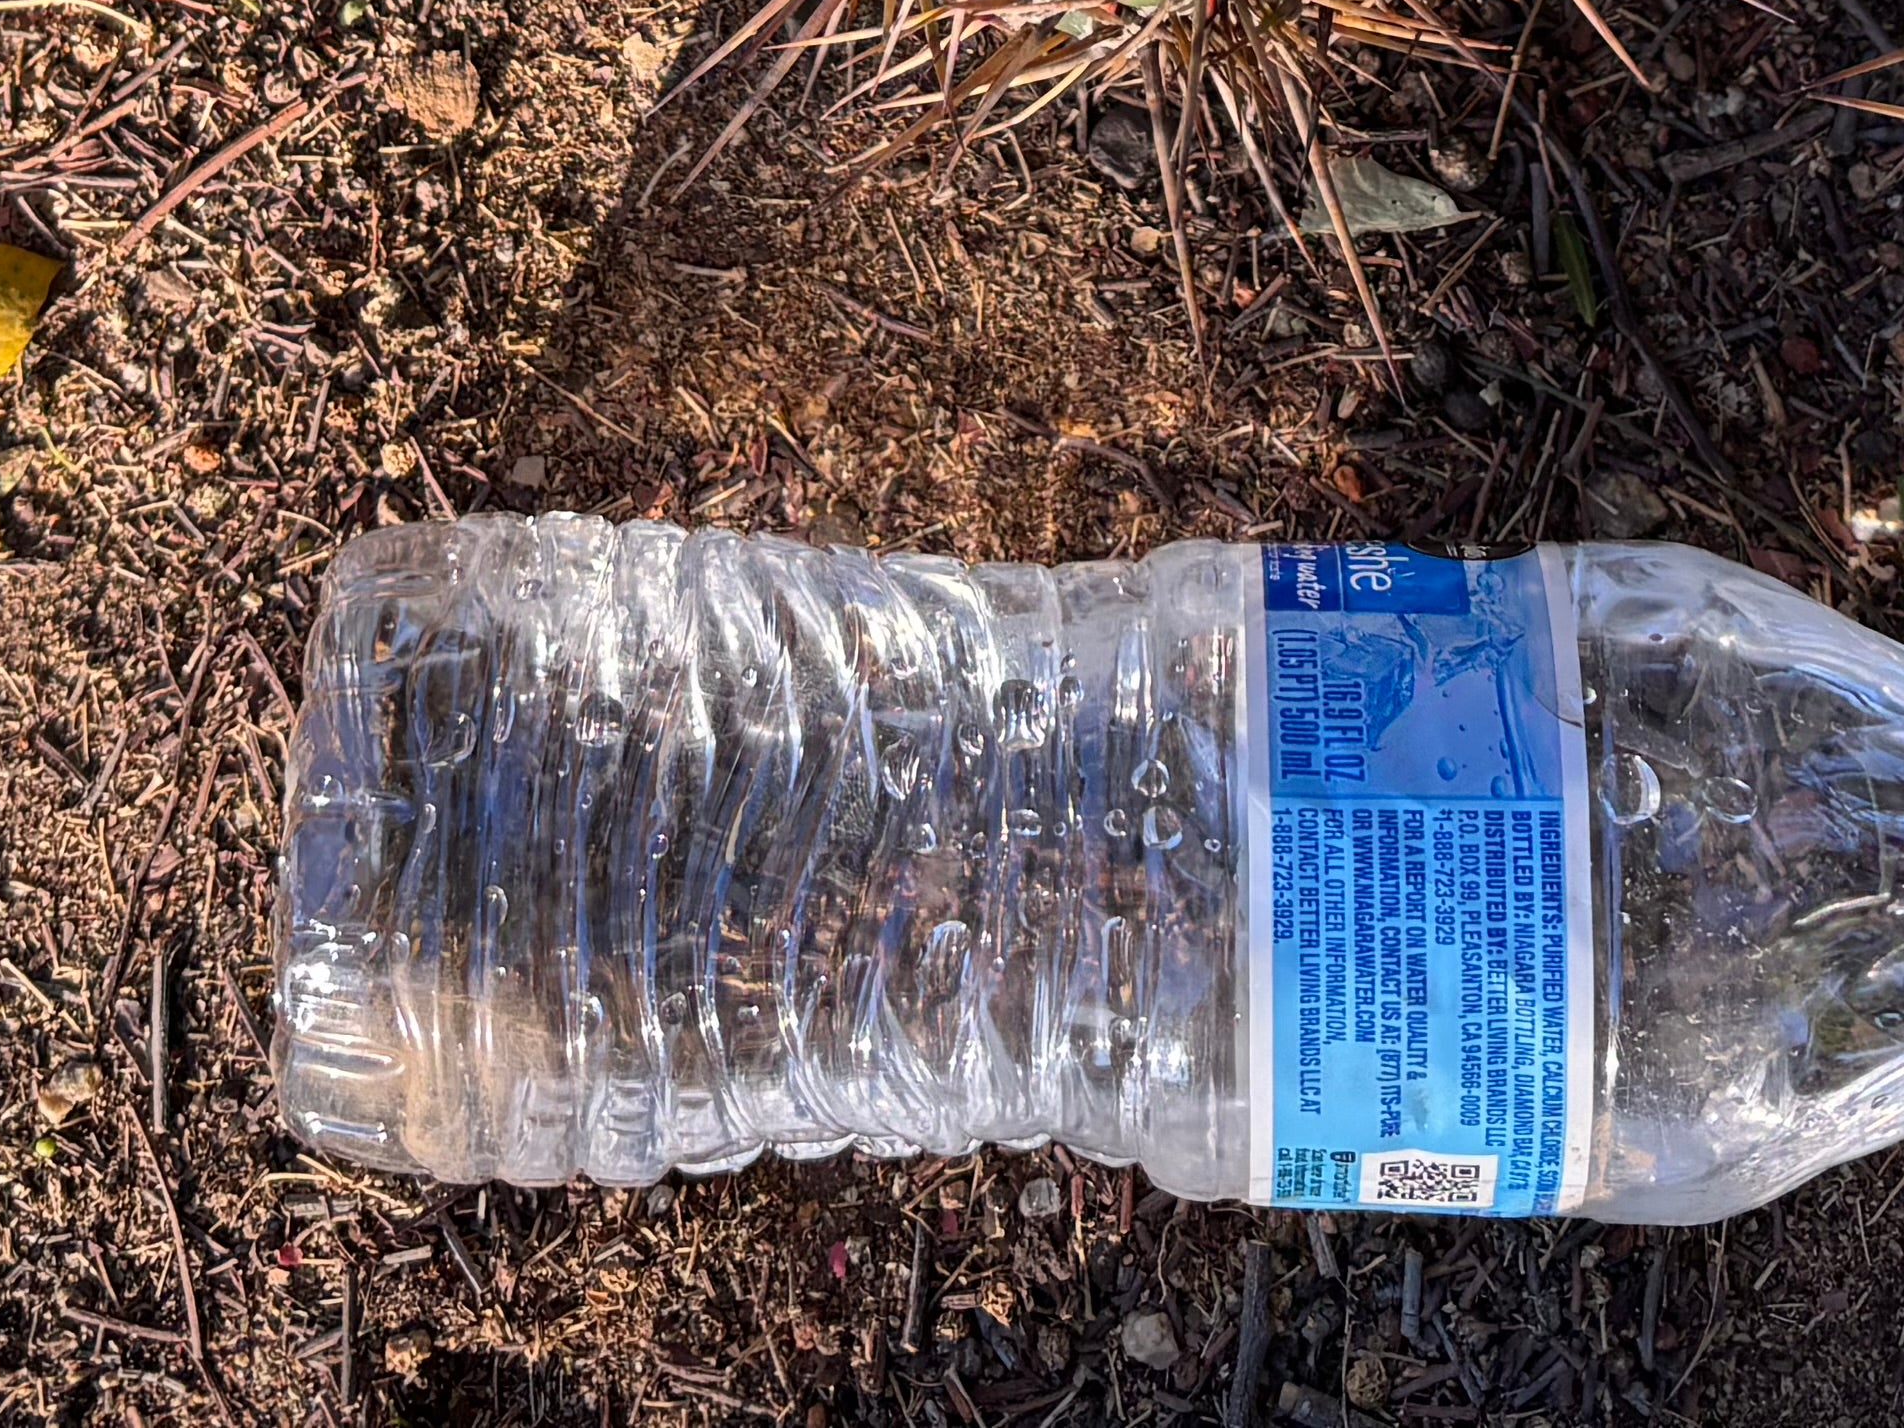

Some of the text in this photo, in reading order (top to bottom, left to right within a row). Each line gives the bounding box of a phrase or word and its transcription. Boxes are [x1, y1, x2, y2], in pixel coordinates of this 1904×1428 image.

[1296, 562, 1326, 609] water
[1273, 629, 1320, 779] (1.05 PT) 500 mL
[1323, 680, 1365, 783] 16.9 FL OZ
[1272, 808, 1294, 944] 1-888-723-3929.
[1512, 811, 1534, 885] BOTTLED
[1540, 811, 1562, 930] INGREDIENTS:
[1323, 808, 1346, 1045] FOR ALL OTHER INFORMATION,
[1352, 809, 1375, 1042] OR WWW.NIAGARAWATER.COM
[1514, 892, 1534, 918] BY:
[1298, 808, 1320, 1114] CONTACT BETTER LIVING BRANDS LLC AT
[1377, 809, 1401, 1137] INFORMATION, CONTACT US AT: (877) ITS-PURE
[1403, 810, 1427, 1080] FOR A REPORT ON WATER QUALITY &
[1457, 810, 1482, 1126] P.O. BOX 99, PLEASANTON, CA 94566-0009
[1484, 810, 1508, 1146] DISTRIBUTED BY: BETTER LIVING BRANDS LLC
[1514, 923, 1535, 994] NIAGARA
[1543, 934, 1563, 1002] PURIFIED
[1512, 999, 1535, 1069] BOTTLING,
[1539, 1006, 1563, 1056] WATER,
[1514, 1074, 1534, 1135] DIAMOND
[1542, 1061, 1562, 1117] CALCIUM
[1508, 1138, 1533, 1157] BAR,
[1510, 1160, 1531, 1170] CA
[1535, 1120, 1562, 1168] CHLORIDE,
